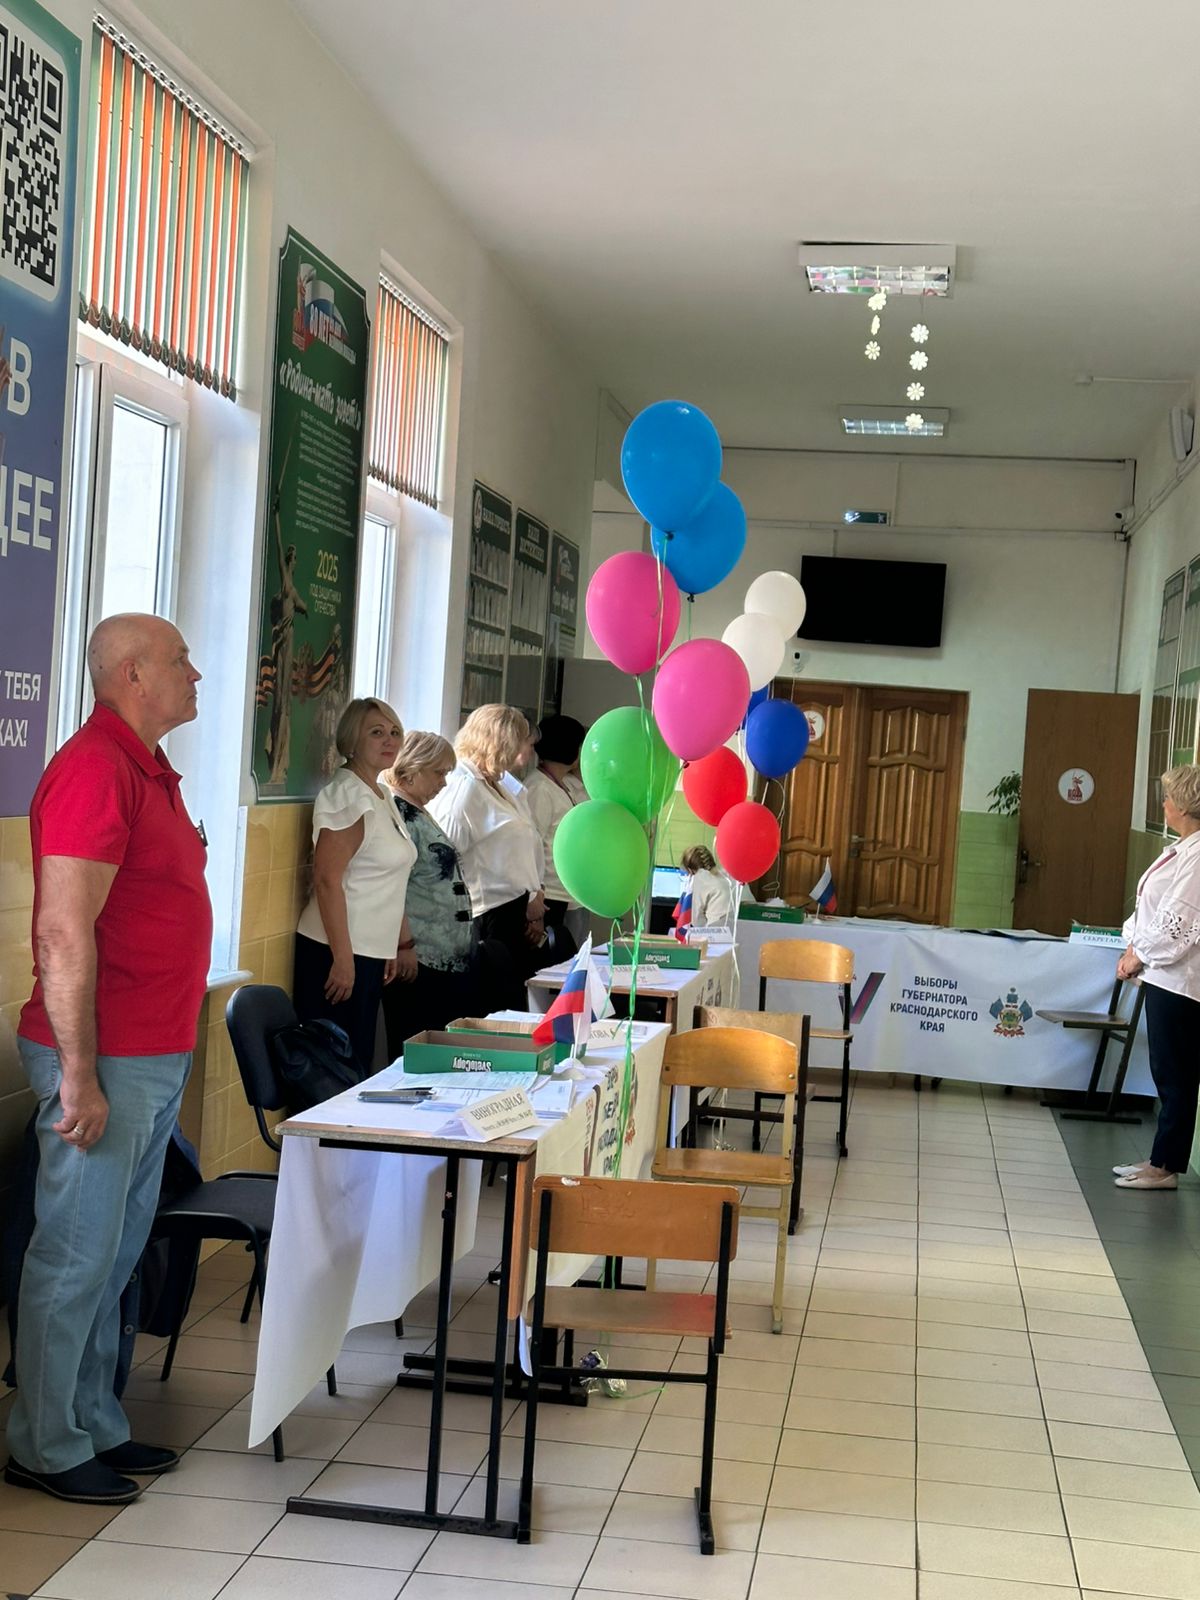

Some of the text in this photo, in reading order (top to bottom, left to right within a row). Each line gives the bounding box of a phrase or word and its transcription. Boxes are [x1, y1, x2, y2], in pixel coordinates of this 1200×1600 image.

[7, 337, 32, 416] В
[316, 549, 338, 582] 2025
[4, 670, 41, 701] ТЕБЯ
[1083, 935, 1122, 944] СЕКРЕТАРЬ
[914, 975, 958, 990] ВЫБОРЫ
[901, 988, 968, 1006] ГУБЕРНАТОРА
[890, 1003, 978, 1022] КРАСНОДАРСКОГО
[919, 1020, 945, 1033] КРАЯ
